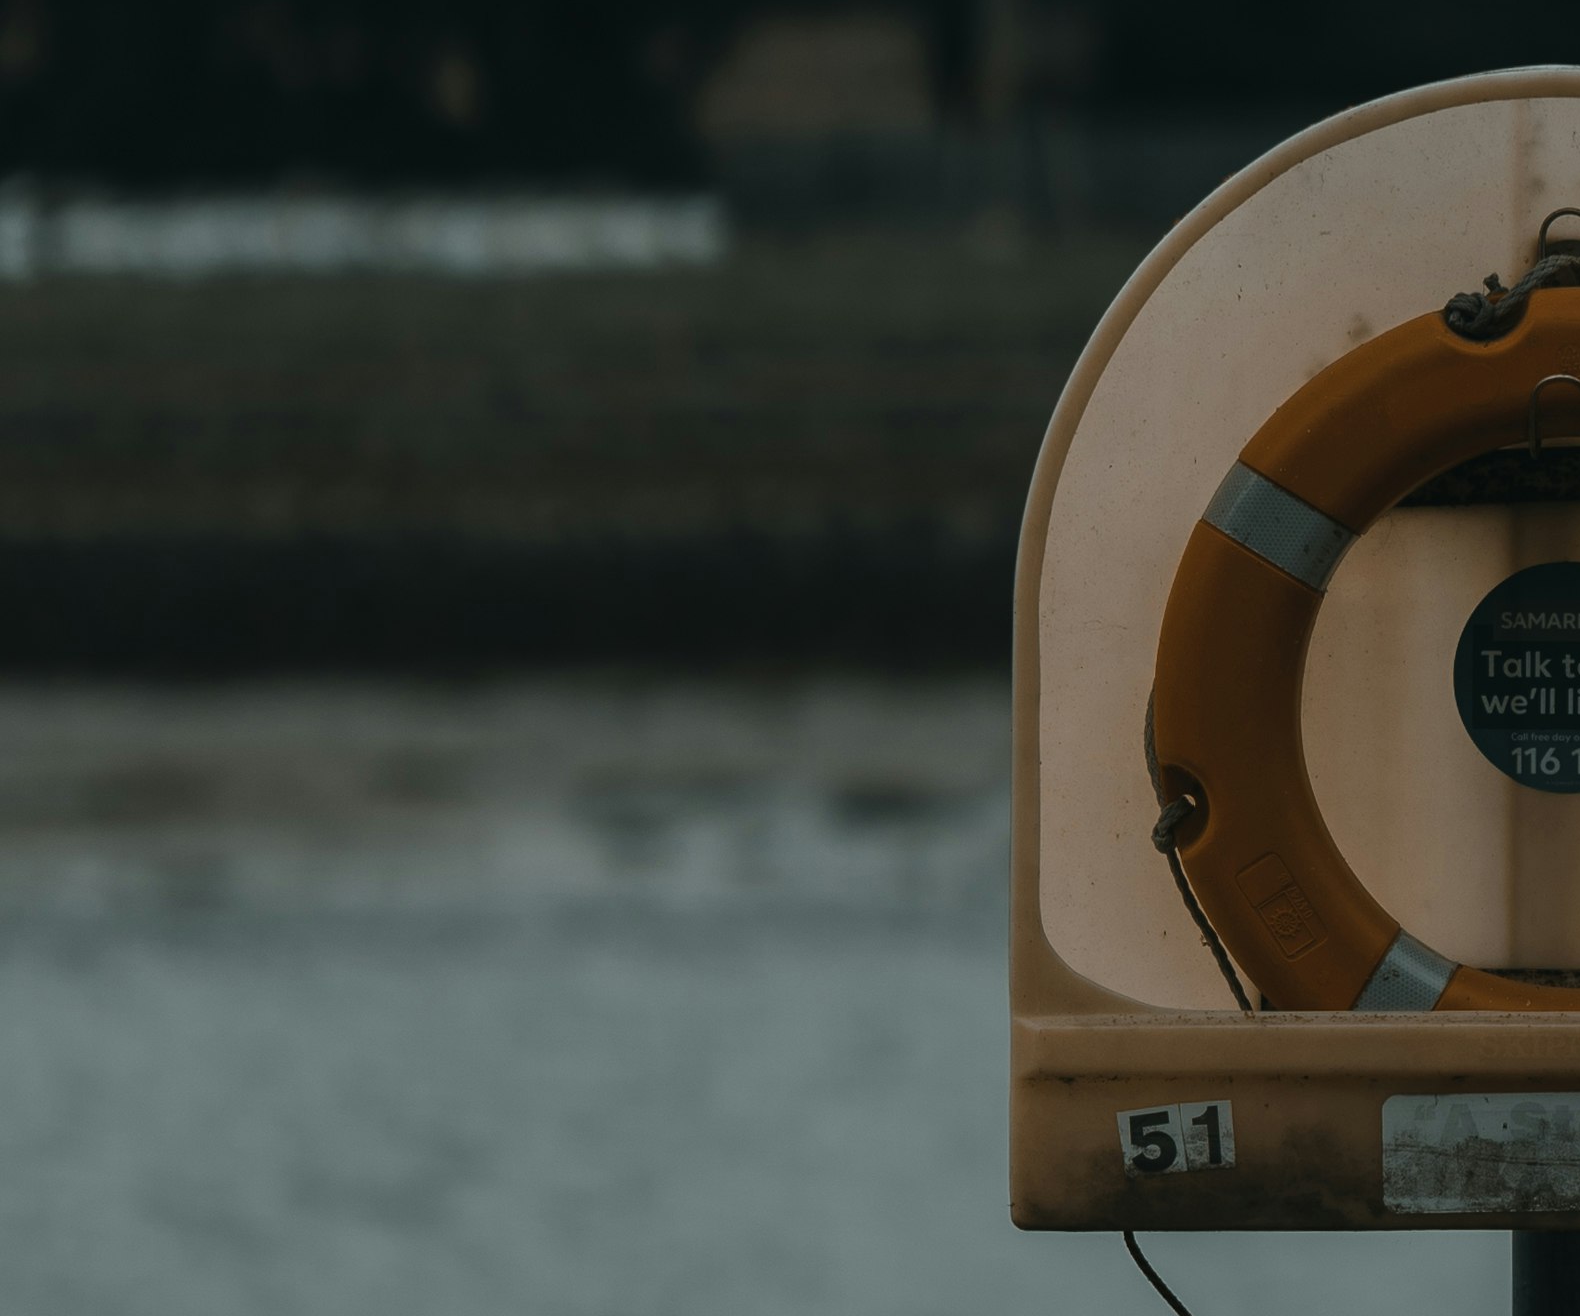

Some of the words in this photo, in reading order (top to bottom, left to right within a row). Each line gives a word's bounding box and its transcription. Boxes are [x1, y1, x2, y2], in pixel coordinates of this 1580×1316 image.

[1480, 650, 1553, 679] Talk
[1480, 687, 1557, 716] we’ll
[1511, 732, 1529, 742] Call
[1531, 732, 1550, 742] free
[1552, 732, 1571, 744] day
[1511, 747, 1562, 776] 116
